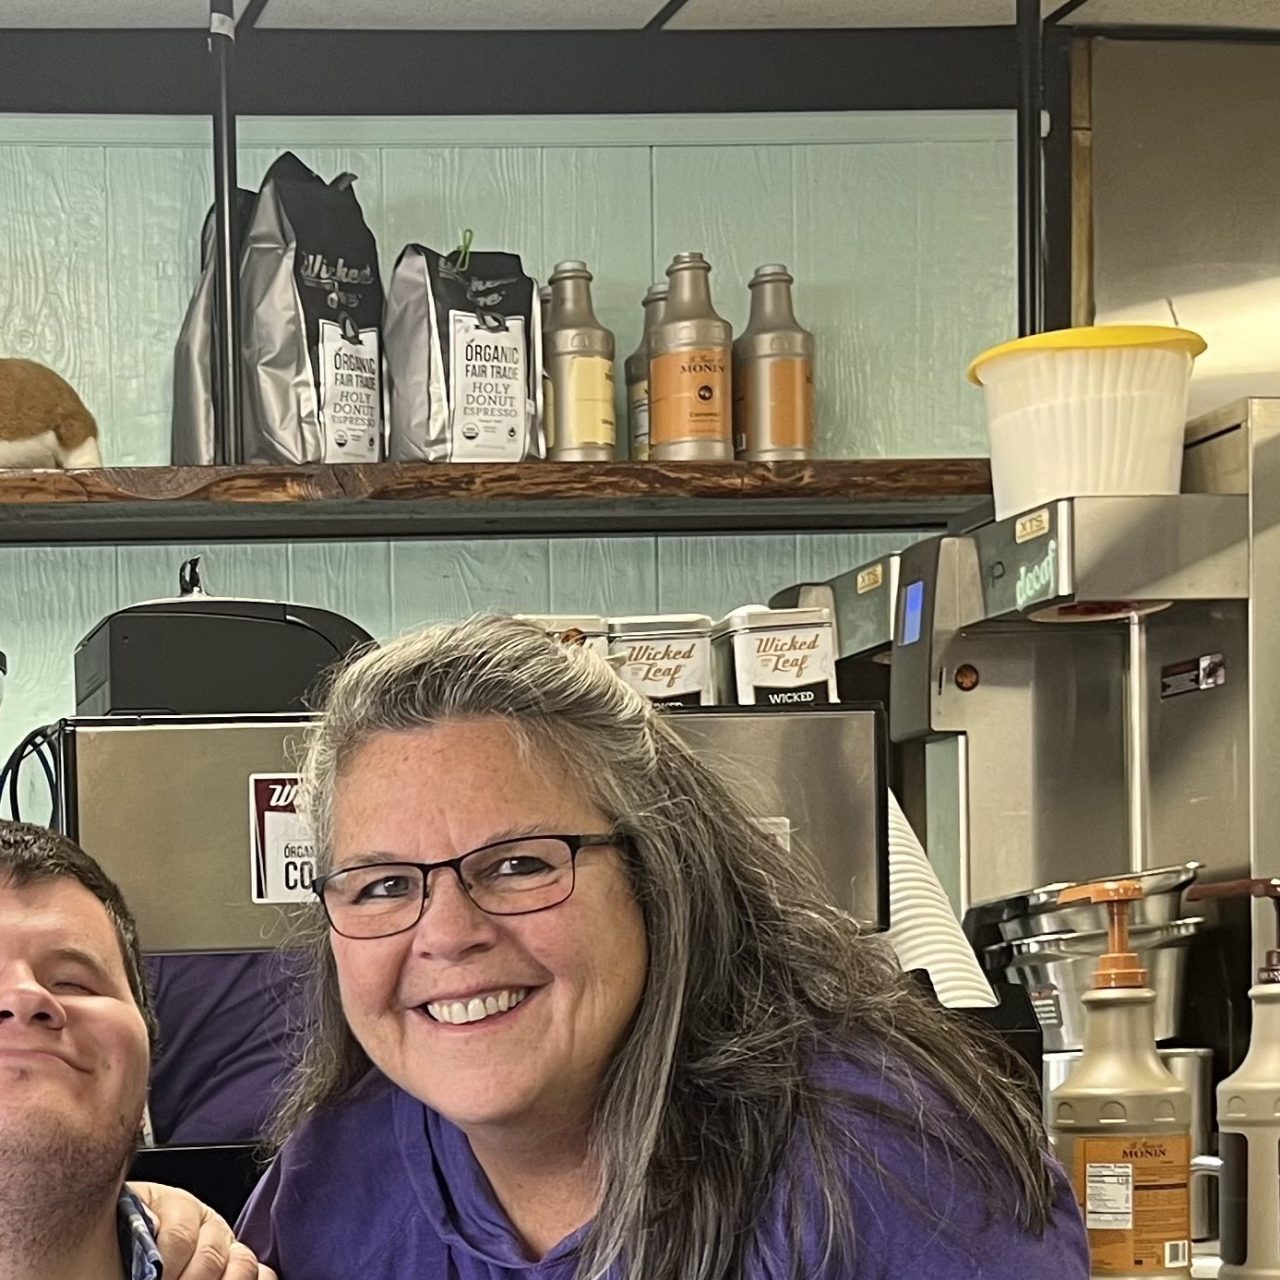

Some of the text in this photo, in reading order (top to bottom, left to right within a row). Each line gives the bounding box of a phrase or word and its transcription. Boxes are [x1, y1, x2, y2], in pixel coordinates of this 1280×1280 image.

[465, 344, 518, 364] ORGANIC
[334, 353, 375, 375] ORGANIC
[466, 364, 518, 380] FAIR TRADE
[473, 382, 510, 395] HOLY
[340, 391, 371, 404] HOLY
[466, 394, 516, 407] DONUT
[333, 403, 374, 417] DONUT
[463, 406, 517, 418] ESPRESSO
[1020, 514, 1043, 531] XTS
[860, 568, 879, 585] XTS
[1016, 540, 1056, 609] decaf
[756, 633, 819, 653] Wicked
[627, 644, 696, 661] Wicked
[772, 654, 809, 678] Leaf
[642, 664, 683, 688] Leaf
[768, 691, 815, 704] WICKED
[1122, 1148, 1167, 1159] MONIN
